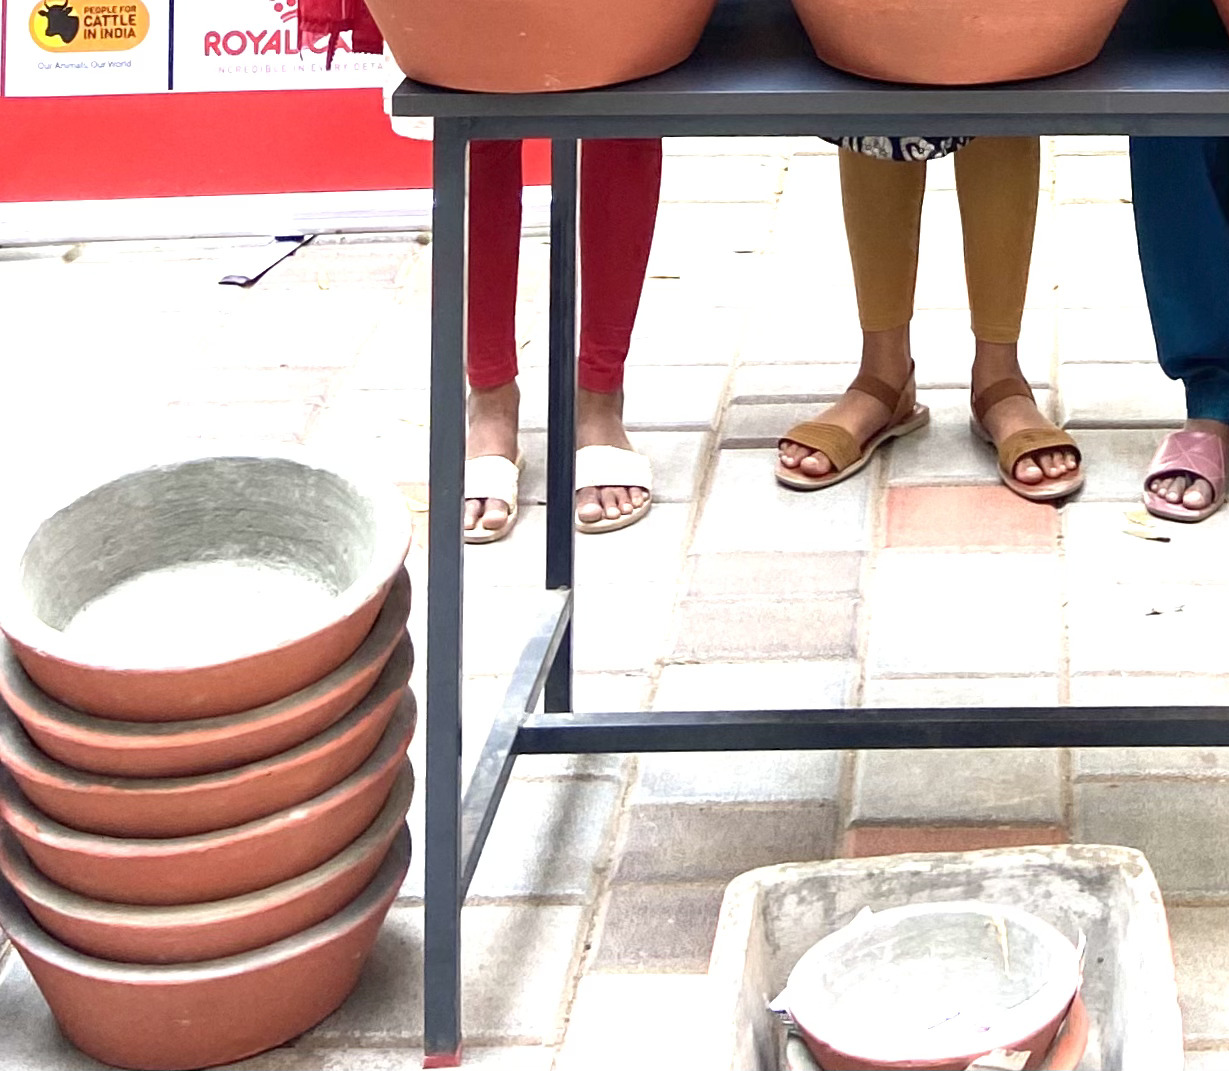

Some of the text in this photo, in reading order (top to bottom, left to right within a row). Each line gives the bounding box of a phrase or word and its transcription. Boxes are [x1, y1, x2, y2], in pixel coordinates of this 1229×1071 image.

[84, 6, 117, 14] PEOPLE
[84, 14, 137, 27] CATTLE
[83, 28, 137, 40] IN INDIA
[204, 30, 301, 57] ROYAL
